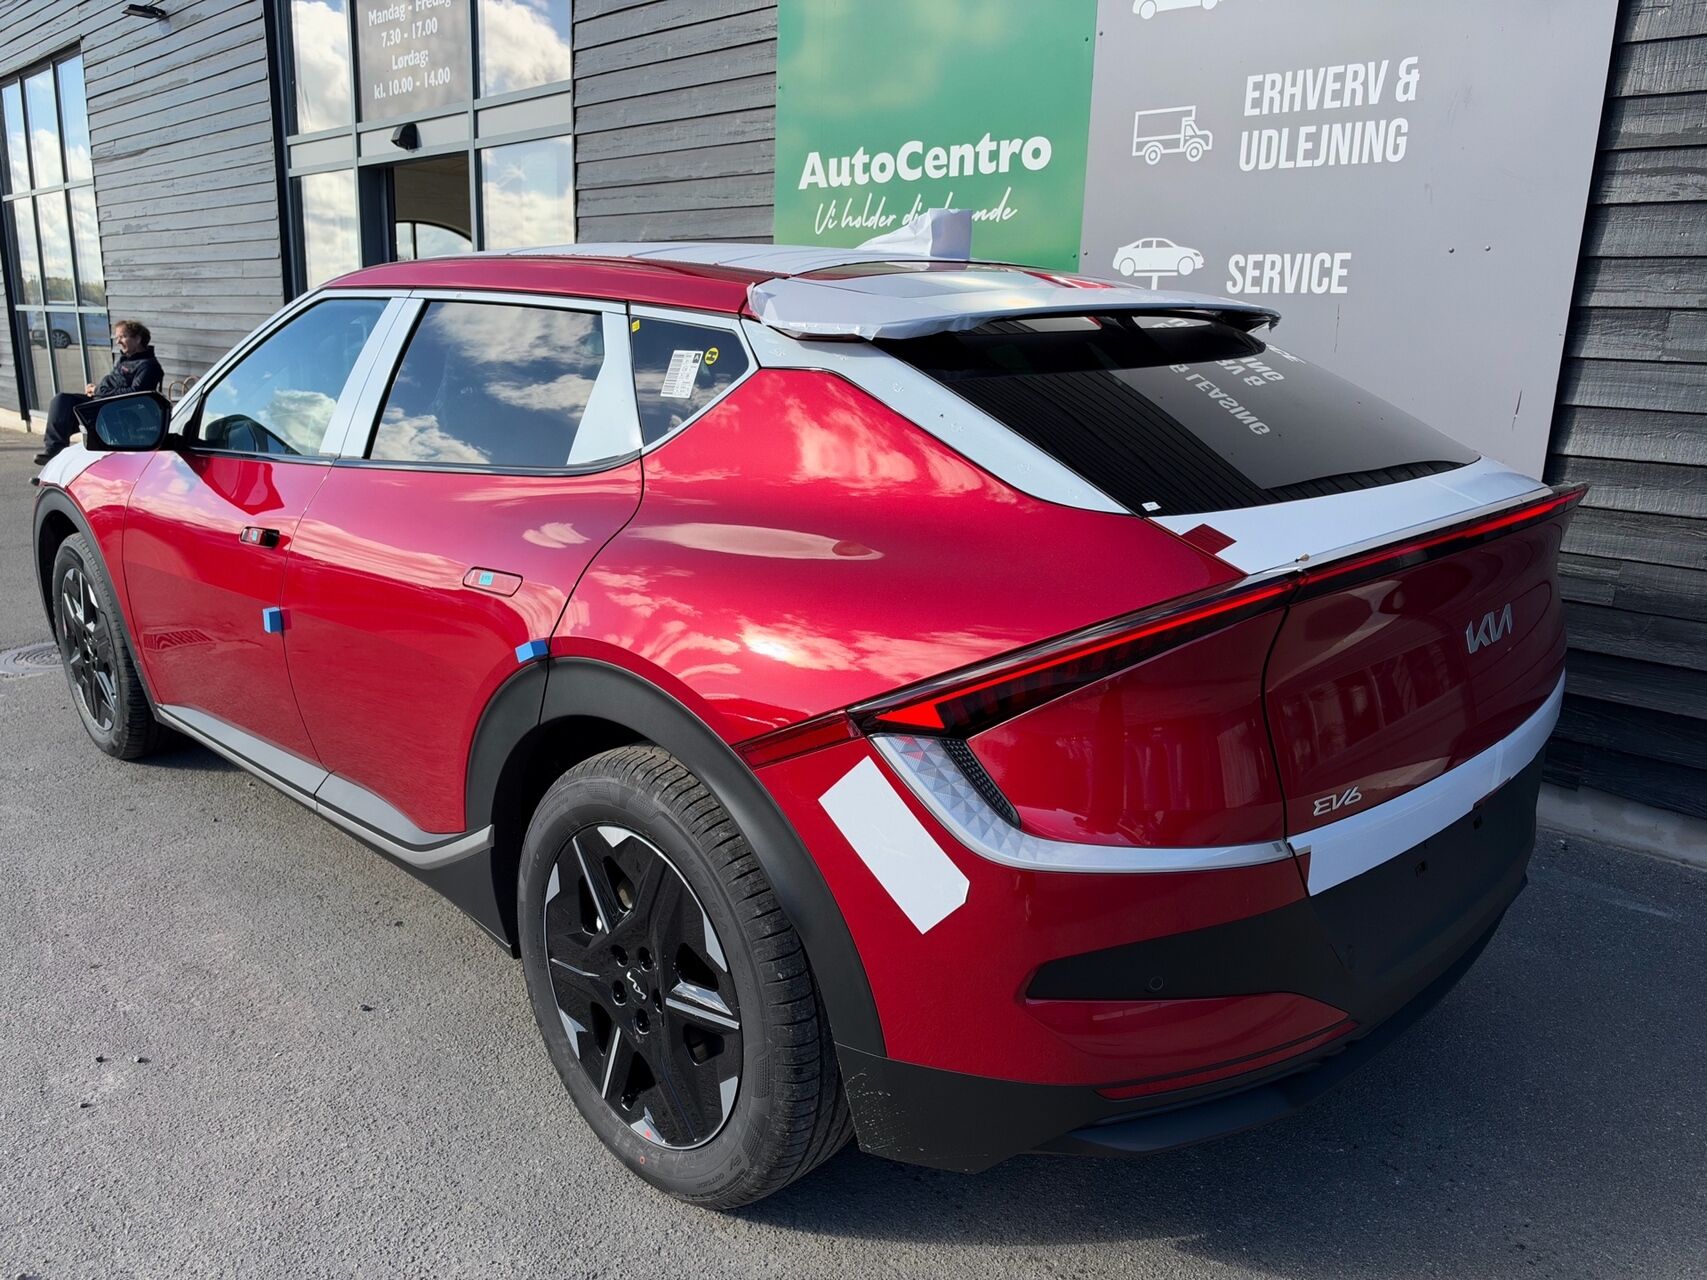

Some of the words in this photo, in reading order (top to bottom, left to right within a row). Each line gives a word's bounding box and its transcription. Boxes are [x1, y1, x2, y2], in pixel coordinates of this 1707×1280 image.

[368, 4, 406, 26] Mandag
[381, 28, 401, 47] 7.30
[412, 17, 438, 39] 17.00
[392, 50, 429, 70] Lørdag:
[374, 82, 386, 99] kl.
[389, 76, 413, 96] 10.00
[424, 67, 451, 88] 14.00
[1244, 60, 1389, 116] ERHVERV
[1396, 56, 1420, 102] &
[798, 132, 1052, 190] AutoCentro
[1239, 118, 1408, 171] UDLEJNING
[815, 200, 837, 235] Vi
[841, 193, 896, 230] holder
[902, 193, 922, 225] di
[1226, 252, 1352, 294] SERVICE
[1465, 603, 1513, 654] KIA
[1313, 785, 1362, 816] EV6
